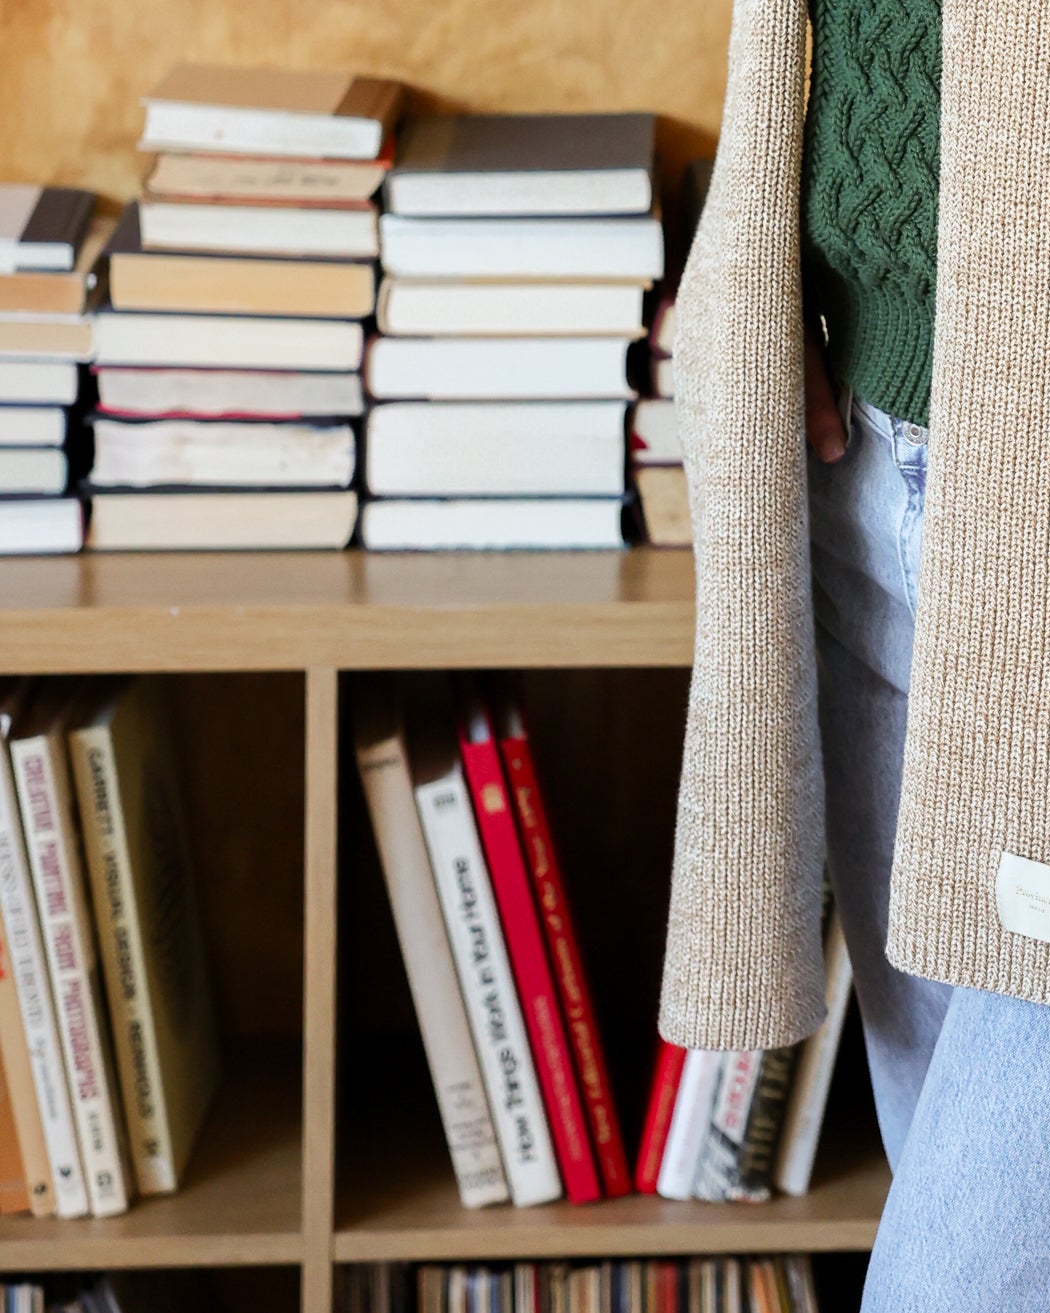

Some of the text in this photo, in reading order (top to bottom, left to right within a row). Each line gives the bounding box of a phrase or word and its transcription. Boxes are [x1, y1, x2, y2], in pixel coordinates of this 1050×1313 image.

[455, 858, 479, 920] Home
[468, 924, 488, 963] Your
[483, 994, 508, 1042] Work
[500, 1049, 525, 1109] Things
[515, 1116, 536, 1163] How
